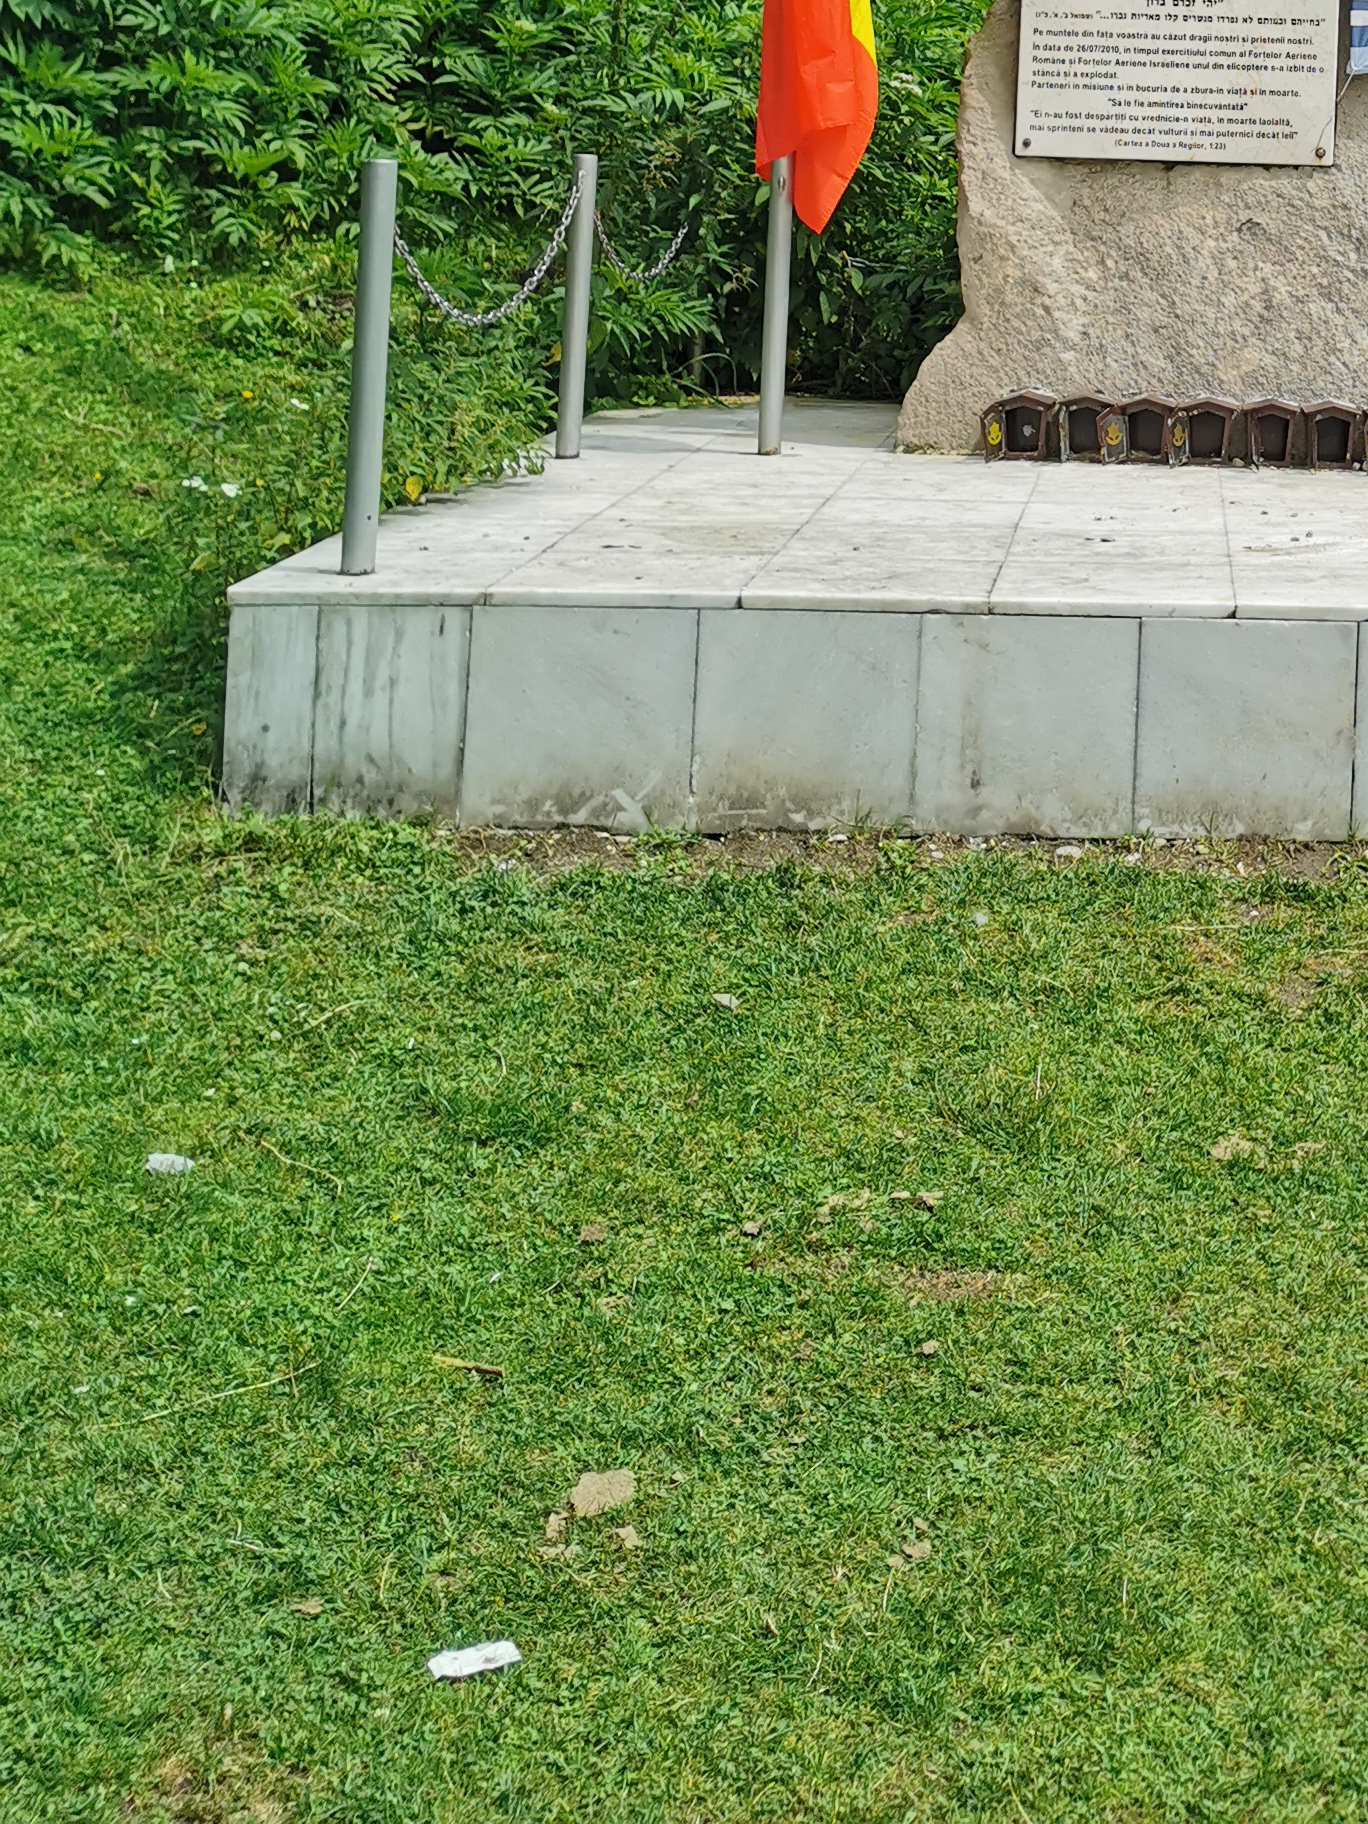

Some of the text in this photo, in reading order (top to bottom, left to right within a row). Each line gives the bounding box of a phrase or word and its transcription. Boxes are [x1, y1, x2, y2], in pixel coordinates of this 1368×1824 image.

[1130, 12, 1160, 21] מאריות
[1164, 12, 1178, 22] קלו
[1182, 14, 1213, 23] מנשרים
[1216, 15, 1238, 24] נפרדו
[1241, 14, 1253, 24] לא
[1256, 17, 1286, 25] ובמותם
[1033, 27, 1043, 36] Pe
[1045, 29, 1079, 37] muntele
[1081, 29, 1094, 37] din
[1188, 33, 1212, 43] dragii
[1250, 36, 1285, 46] prietenii
[1042, 43, 1061, 51] data
[1063, 44, 1074, 52] de
[1133, 47, 1159, 56] timpul
[1238, 50, 1246, 58] al
[1284, 51, 1317, 60] Aeriene
[1114, 58, 1147, 67] Aeriene
[1149, 60, 1190, 68] Israeliene
[1191, 61, 1209, 69] unul
[1211, 62, 1224, 70] din
[1226, 62, 1268, 72] elicoptere
[1286, 64, 1304, 72] izbit
[1306, 65, 1316, 73] de
[1030, 80, 1070, 89] Parteneri
[1081, 83, 1114, 91] misiune
[1135, 84, 1167, 93] bucuria
[1169, 85, 1180, 93] de
[1123, 99, 1184, 109] le fie amintirea
[1064, 110, 1082, 119] fost
[1226, 117, 1257, 125] moarte
[1046, 124, 1084, 133] sprinteni
[1157, 128, 1187, 136] vulturii
[1215, 130, 1253, 138] puternici
[1151, 140, 1170, 148] Doua
